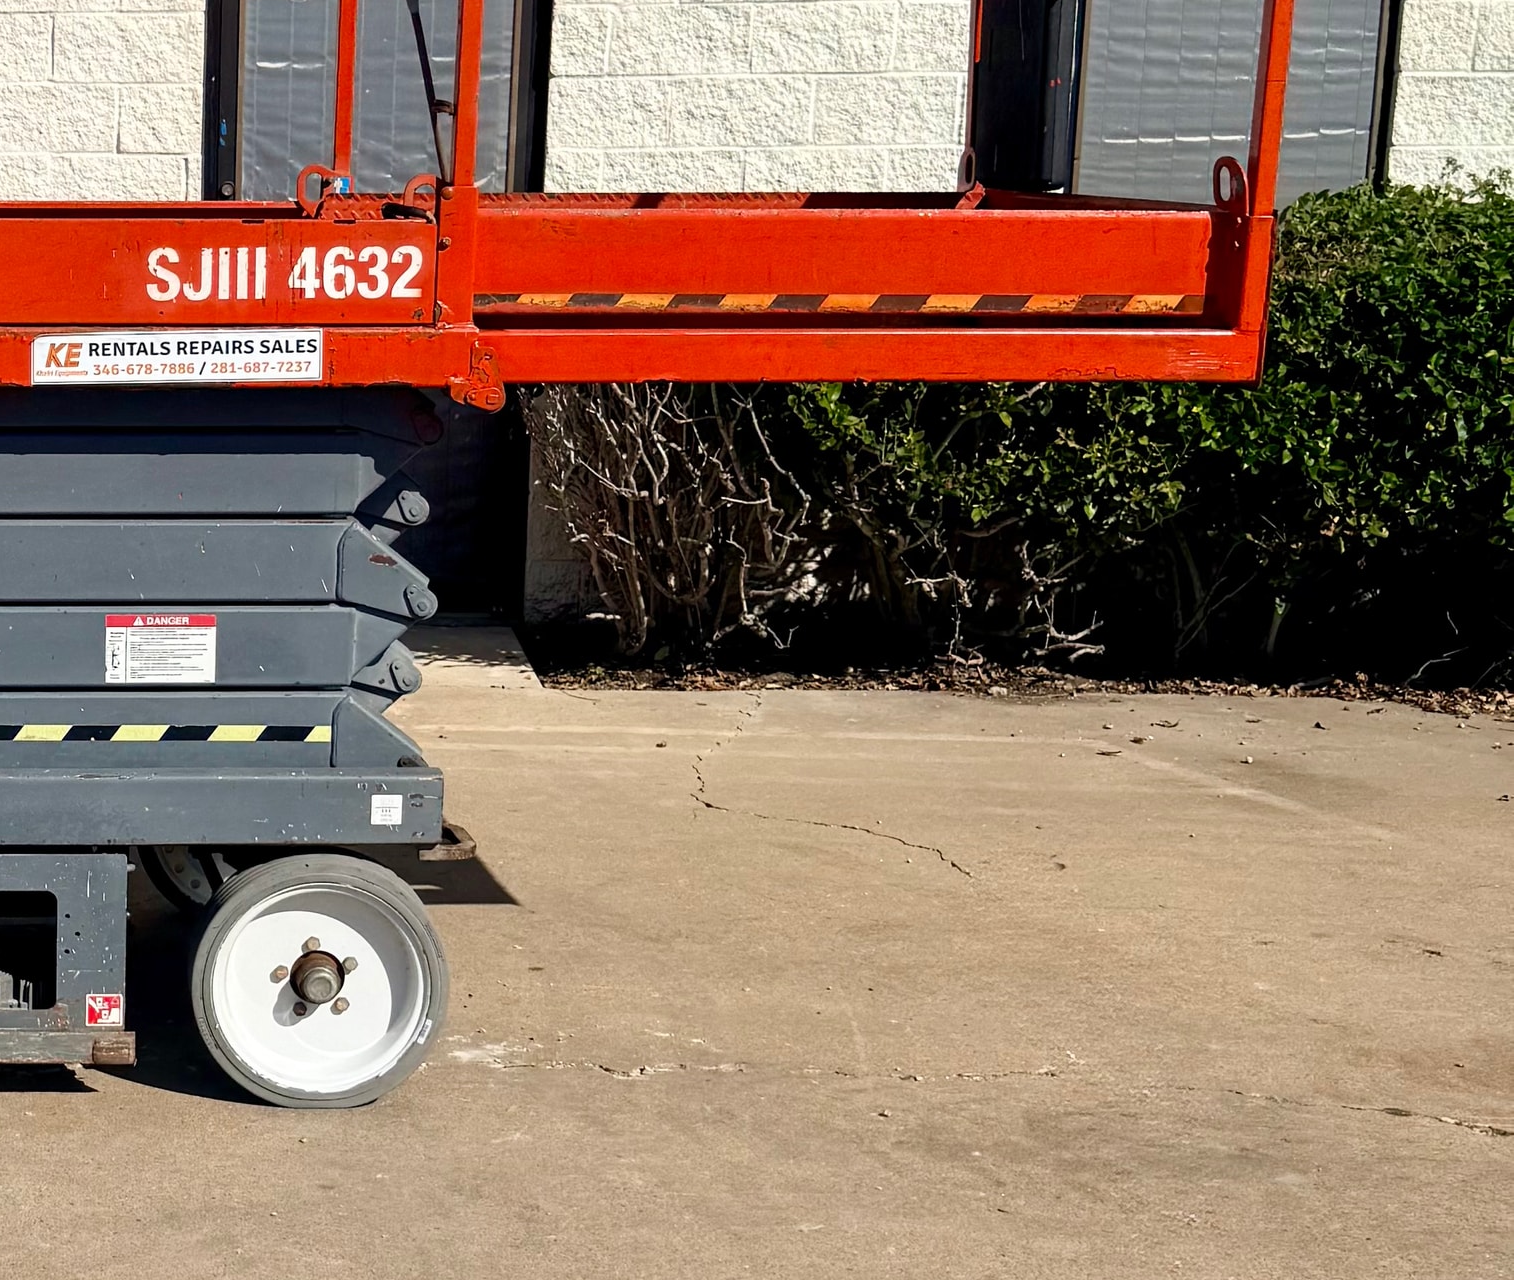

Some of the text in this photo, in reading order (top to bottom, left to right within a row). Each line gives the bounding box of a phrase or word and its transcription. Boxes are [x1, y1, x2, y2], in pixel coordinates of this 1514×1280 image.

[146, 245, 423, 302] SJIII 4632
[45, 342, 84, 368] KE
[88, 338, 318, 357] RENTALS REPAIRS SALES
[93, 361, 312, 376] 346-678-7886 / 281-687-7237
[146, 616, 190, 625] DANGER
